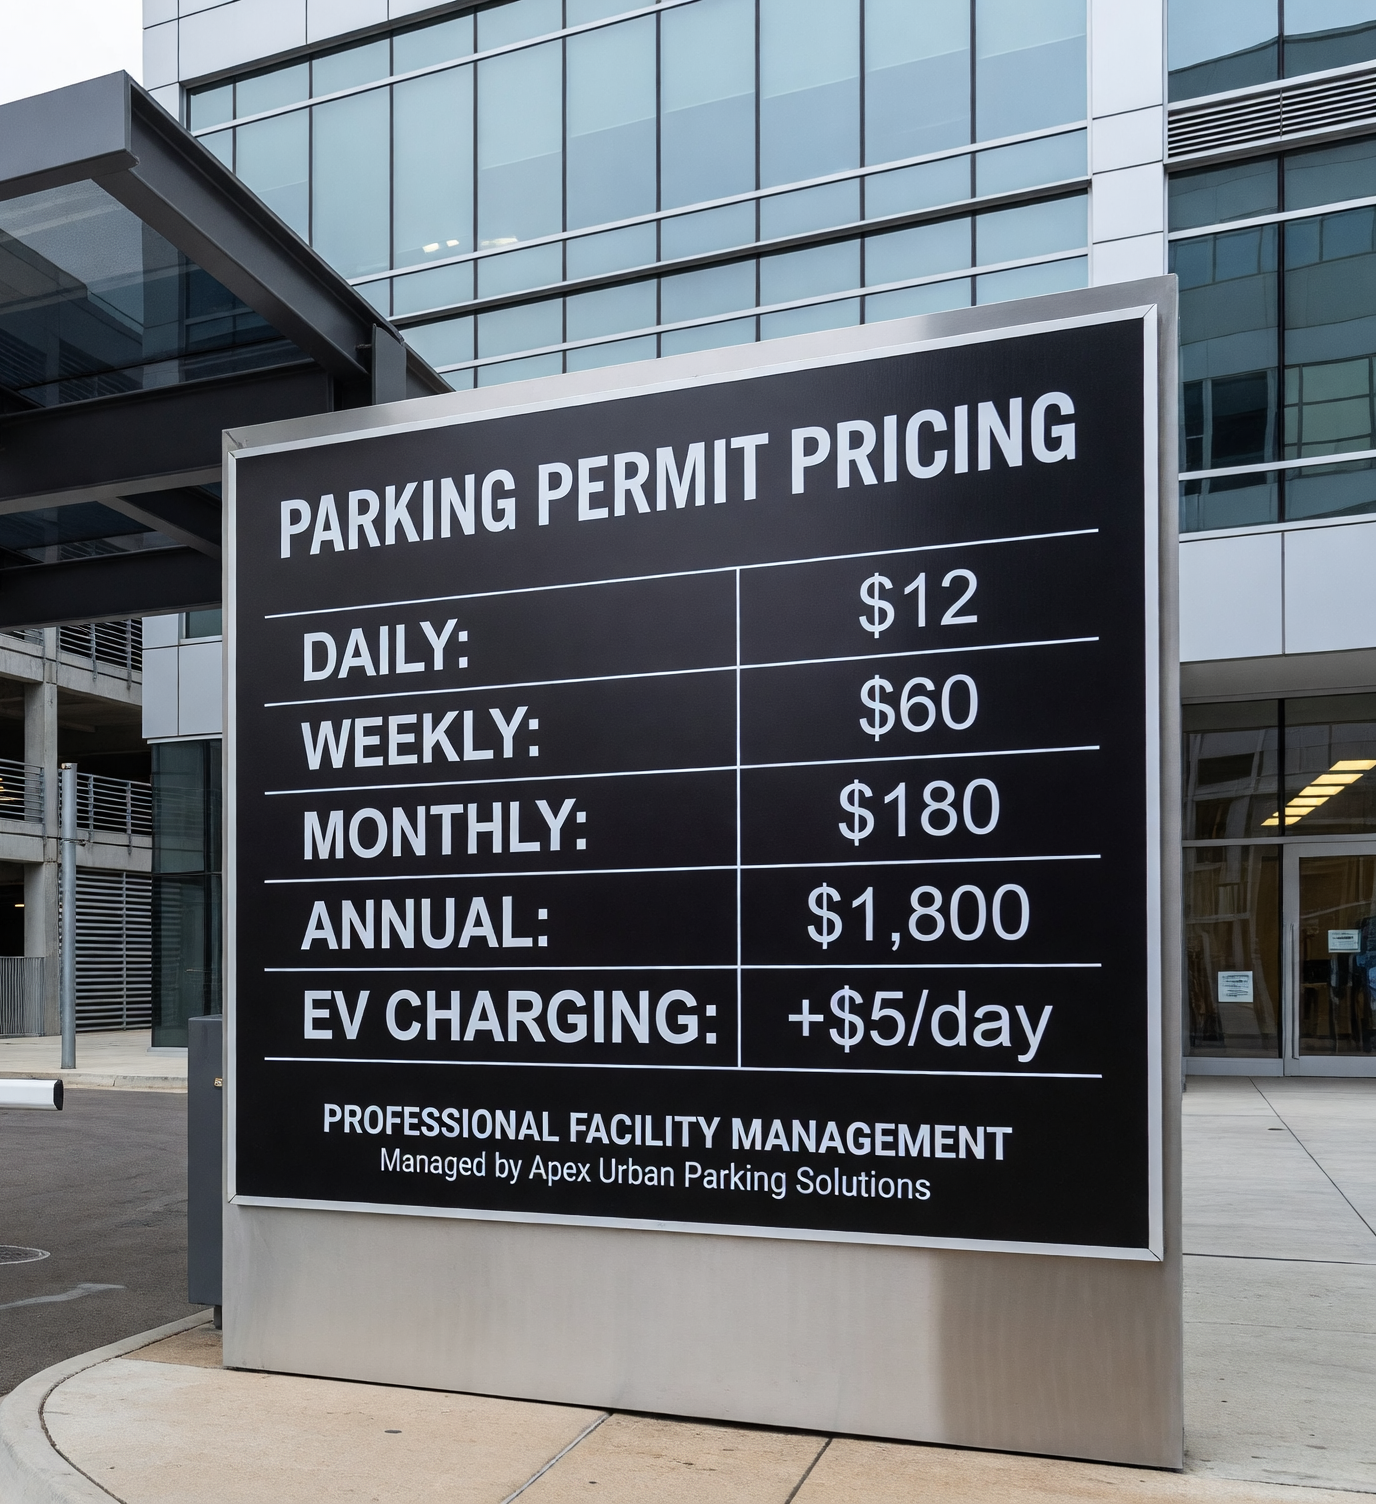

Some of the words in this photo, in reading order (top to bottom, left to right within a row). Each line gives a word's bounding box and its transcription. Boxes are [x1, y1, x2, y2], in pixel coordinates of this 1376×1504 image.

[281, 469, 515, 558] PARKING
[538, 432, 769, 526] PERMIT
[791, 392, 1075, 494] PRICING
[304, 618, 468, 681] DAILY:
[859, 569, 977, 638] $12
[301, 706, 539, 770] WEEKLY:
[860, 674, 978, 741] $60
[304, 798, 586, 860] MONTHLY:
[839, 778, 999, 846] $180
[301, 896, 547, 950] ANNUAL:
[808, 882, 1029, 951] $1,800
[304, 991, 370, 1039] EV
[386, 990, 716, 1044] CHARGING:
[789, 985, 1053, 1062] +$5/day
[324, 1104, 559, 1141] PROFESSIONAL
[570, 1112, 720, 1148] FACILITY
[732, 1118, 1012, 1160] MANAGEMENT
[381, 1148, 485, 1181] Managed
[496, 1152, 522, 1184] by
[529, 1155, 591, 1186] Apex
[600, 1158, 674, 1186] Urban
[685, 1162, 786, 1199] Parking
[796, 1167, 930, 1200] Solutions
